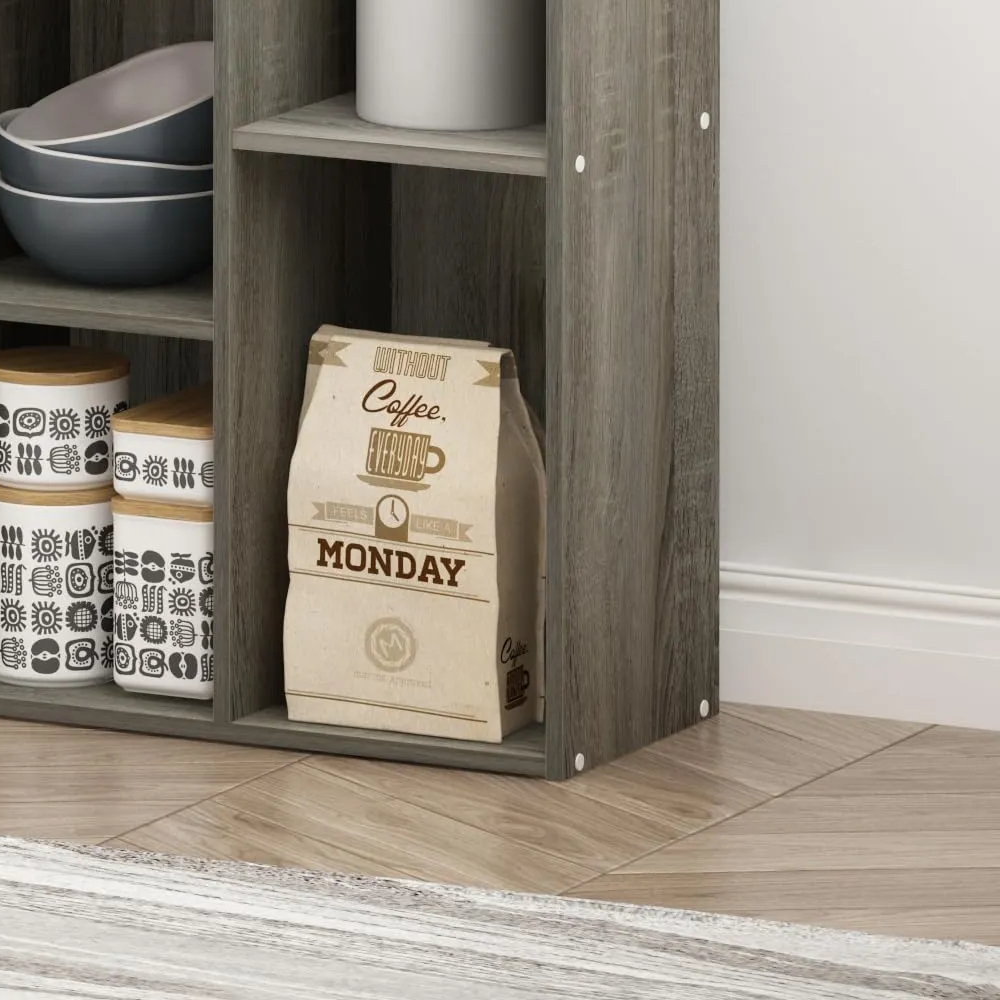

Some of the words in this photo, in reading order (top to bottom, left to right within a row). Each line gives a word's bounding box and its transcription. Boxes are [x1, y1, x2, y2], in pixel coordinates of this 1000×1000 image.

[373, 346, 451, 381] WITHOUT
[368, 430, 429, 478] EVERYDAY
[333, 506, 367, 520] FEELS
[416, 518, 440, 531] LIKE
[443, 524, 452, 534] A
[316, 537, 466, 587] MONDAY
